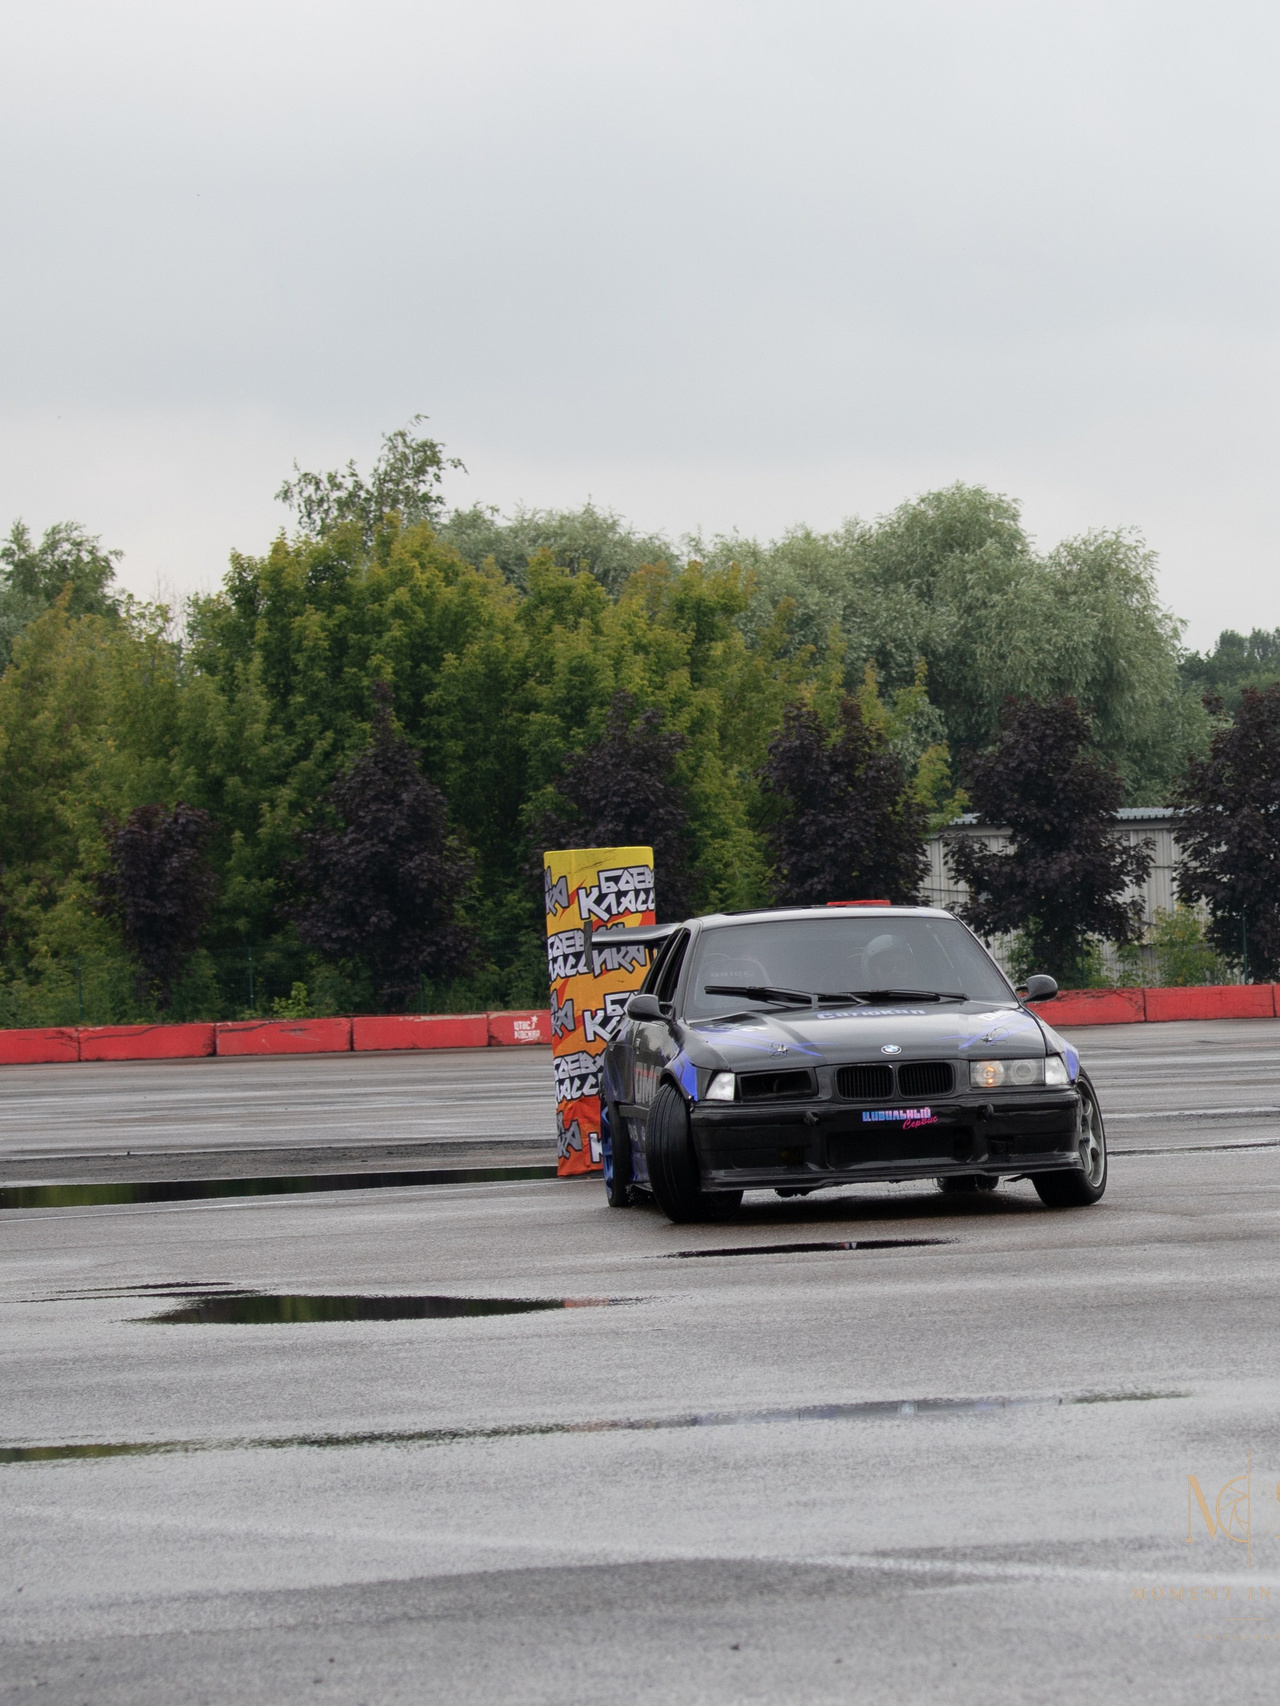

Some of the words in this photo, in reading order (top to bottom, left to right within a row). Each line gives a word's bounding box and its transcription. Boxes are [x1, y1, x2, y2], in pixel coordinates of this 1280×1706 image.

[599, 866, 654, 893] БОЕВ
[862, 1107, 931, 1122] ЦИВИЛЬНЫЙ
[902, 1116, 938, 1130] Сервис
